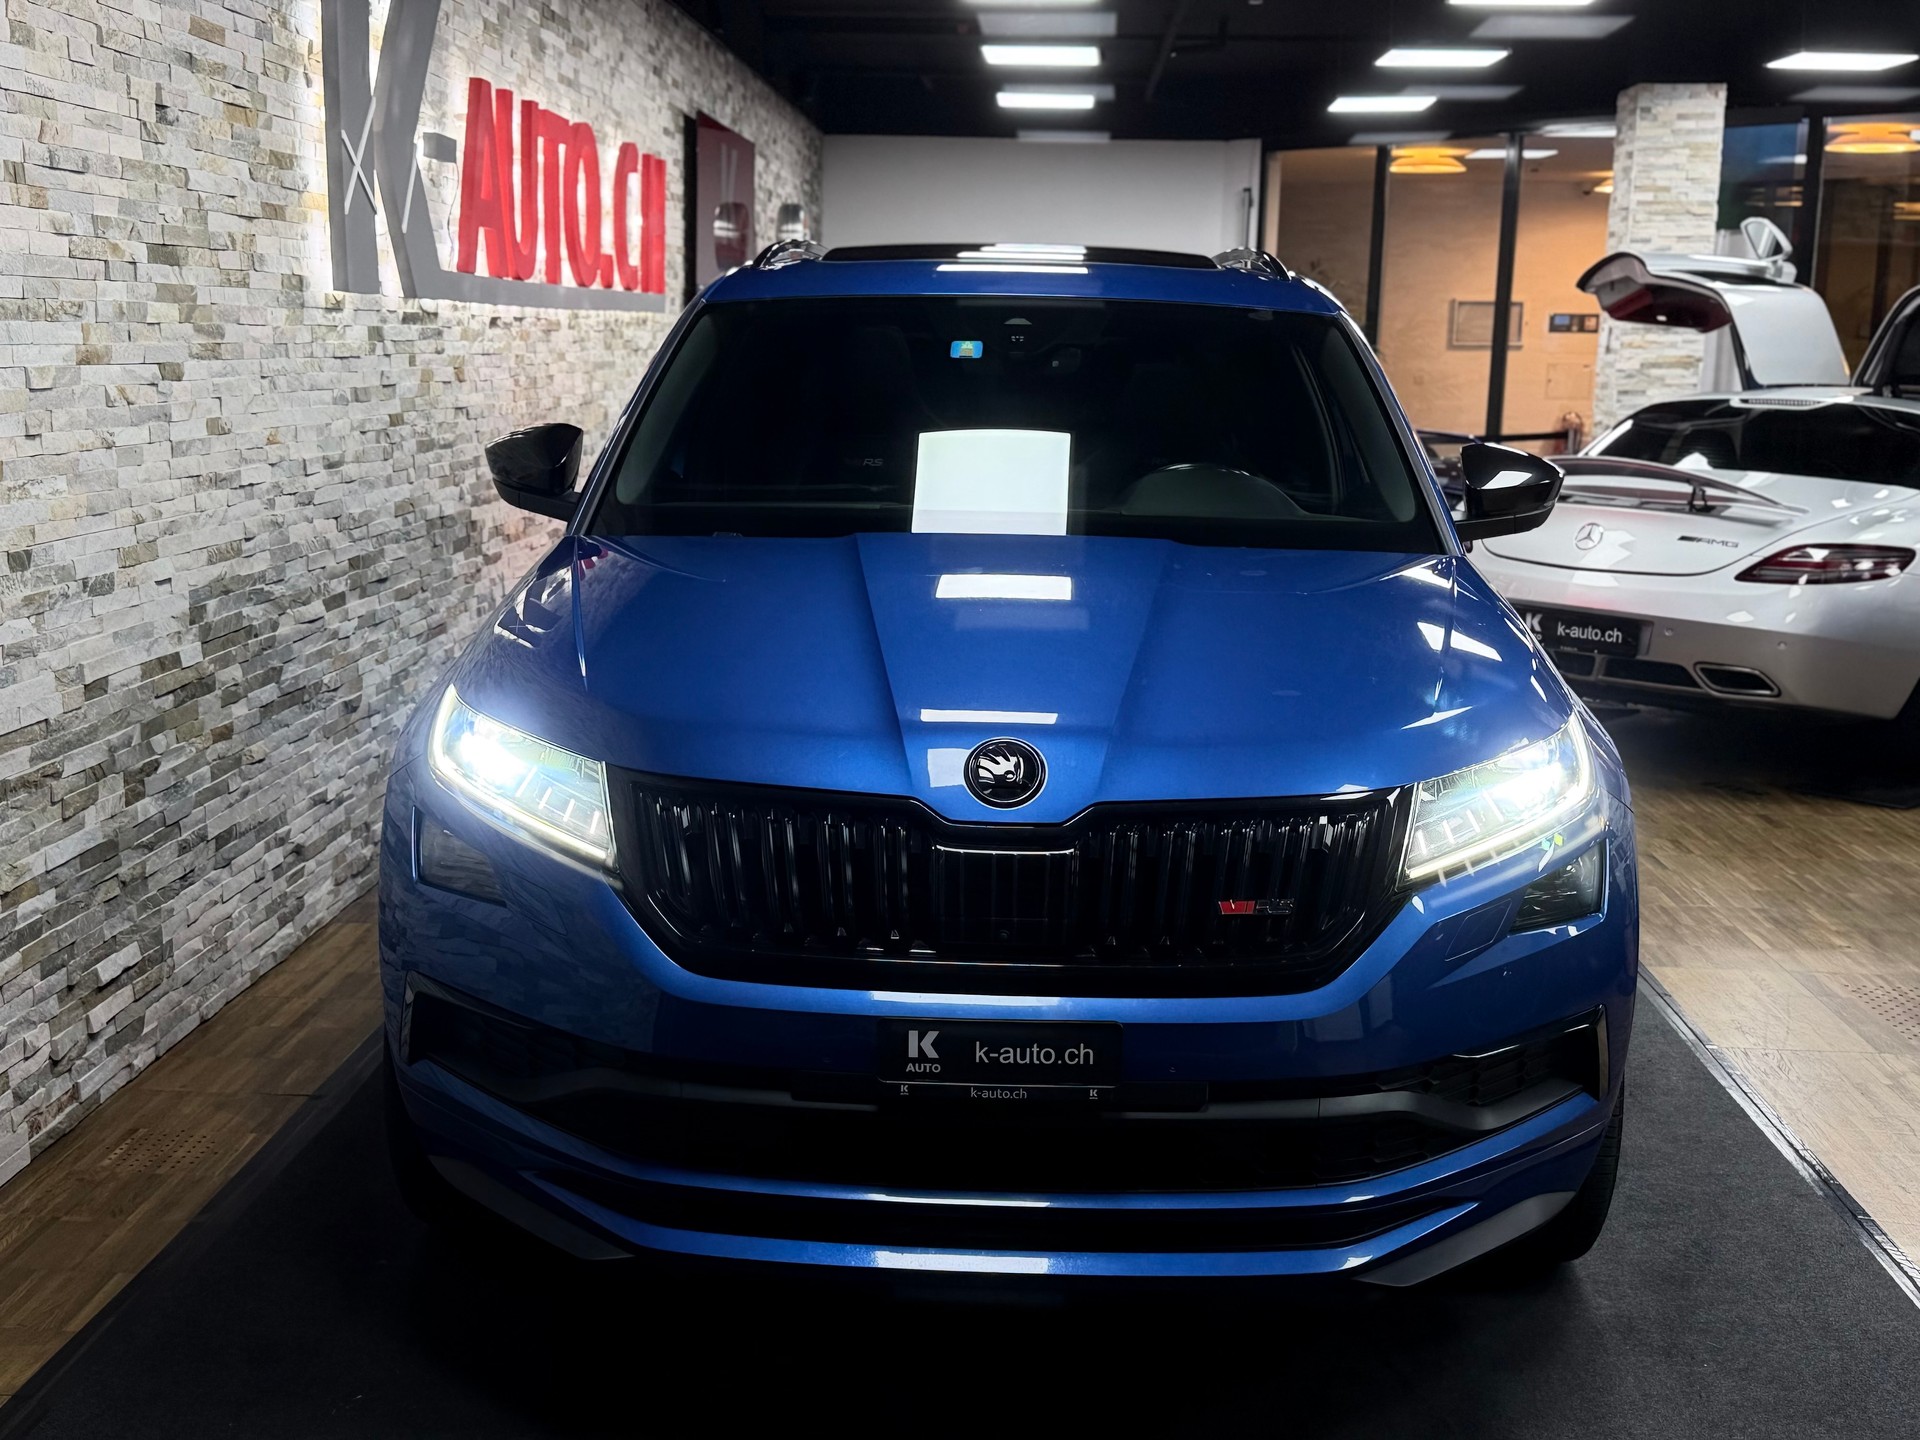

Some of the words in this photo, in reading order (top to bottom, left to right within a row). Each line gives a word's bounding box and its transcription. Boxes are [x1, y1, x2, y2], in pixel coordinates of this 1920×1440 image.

[862, 458, 884, 467] RS
[1694, 536, 1740, 549] AMG
[1557, 621, 1623, 643] k-auto.ch
[908, 1030, 940, 1059] K
[974, 1041, 1094, 1065] k-auto.ch
[906, 1063, 941, 1073] AUTO
[970, 1087, 1028, 1100] k-auto.ch
